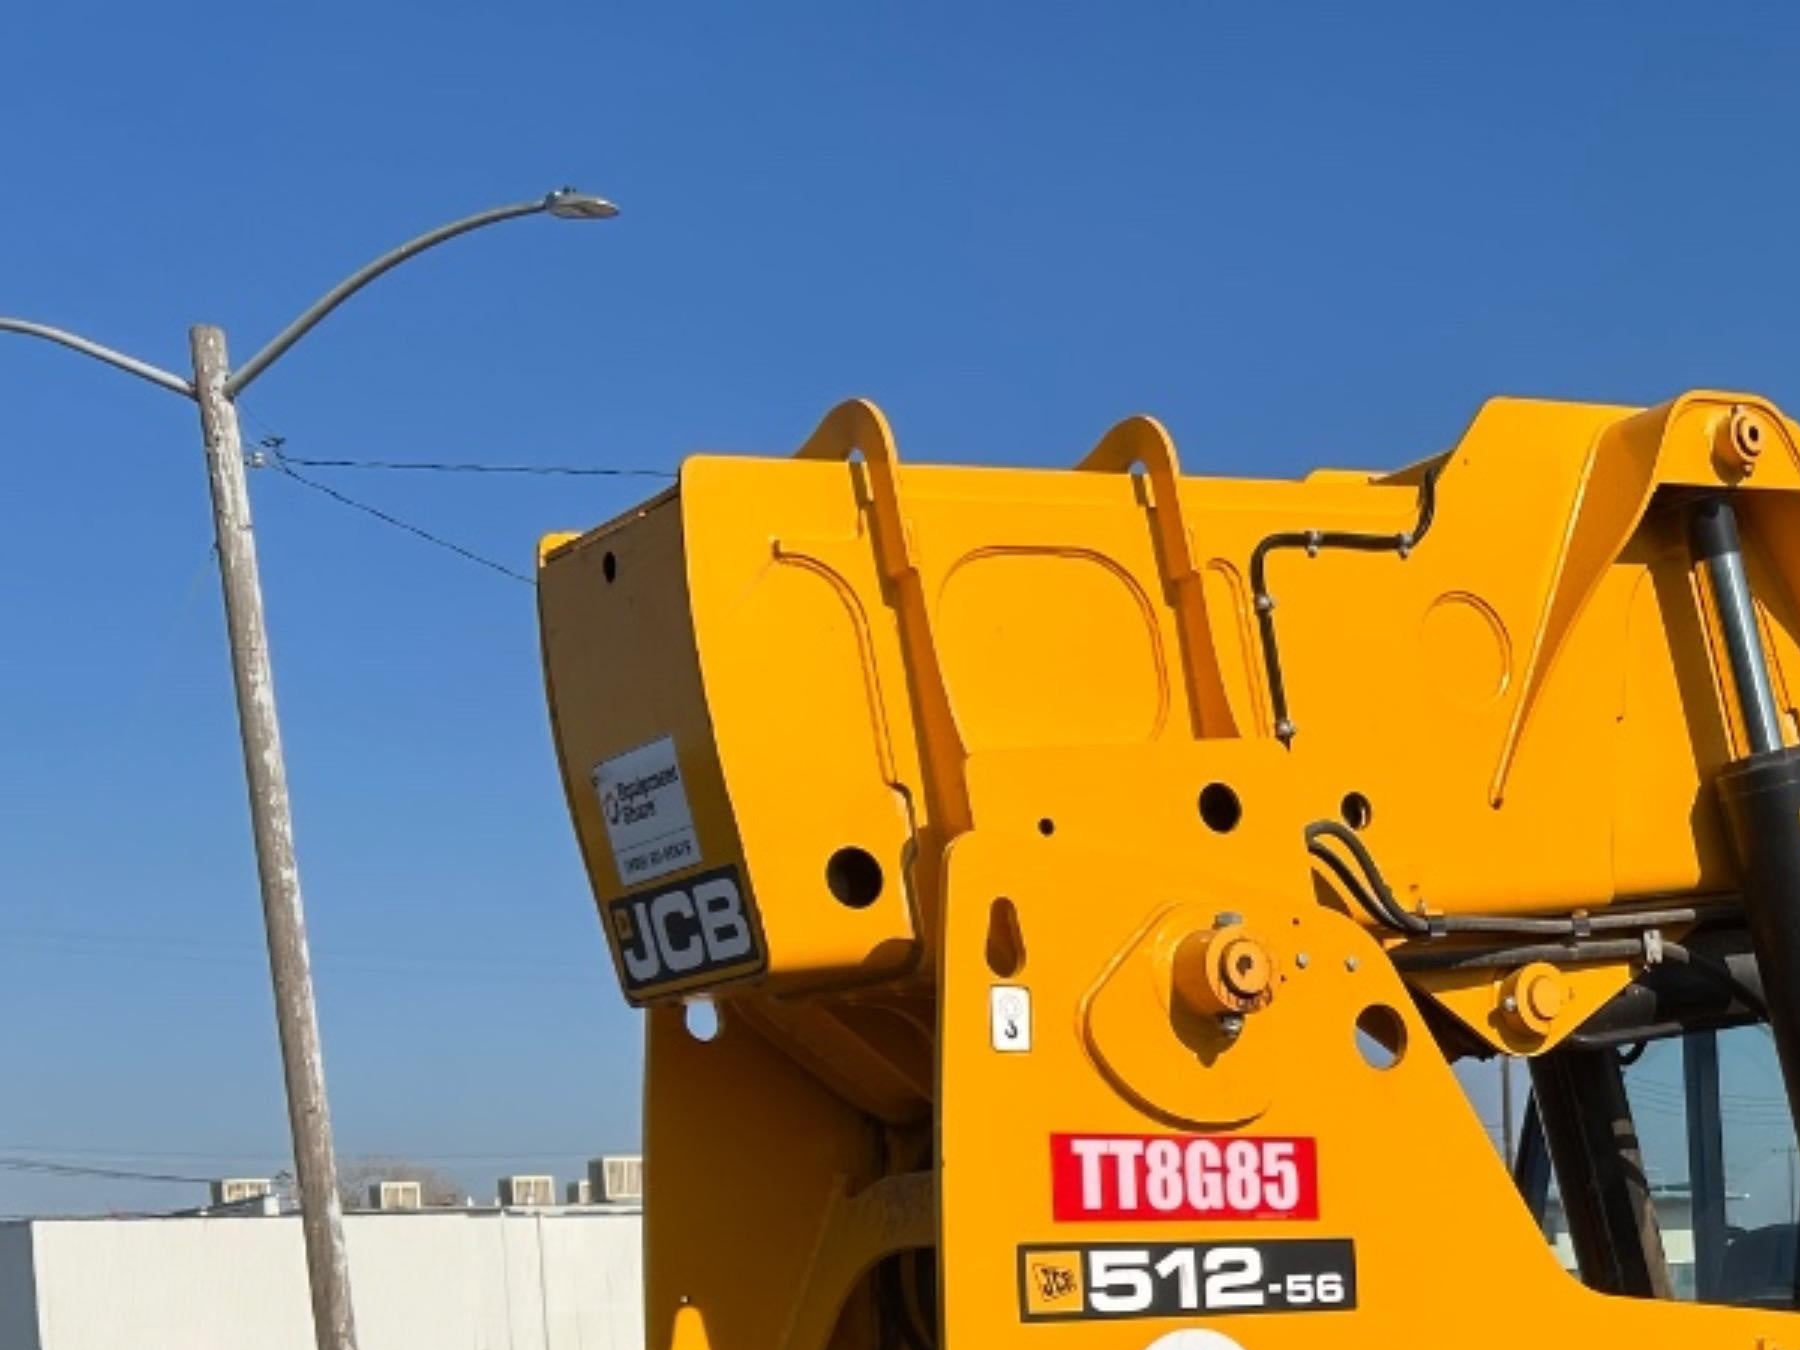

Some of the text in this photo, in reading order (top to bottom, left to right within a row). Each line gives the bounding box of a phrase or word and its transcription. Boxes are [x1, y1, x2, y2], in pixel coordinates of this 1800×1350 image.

[623, 877, 751, 982] JCB
[1070, 1138, 1299, 1212] TT8G85
[1087, 1247, 1346, 1313] 512-56
